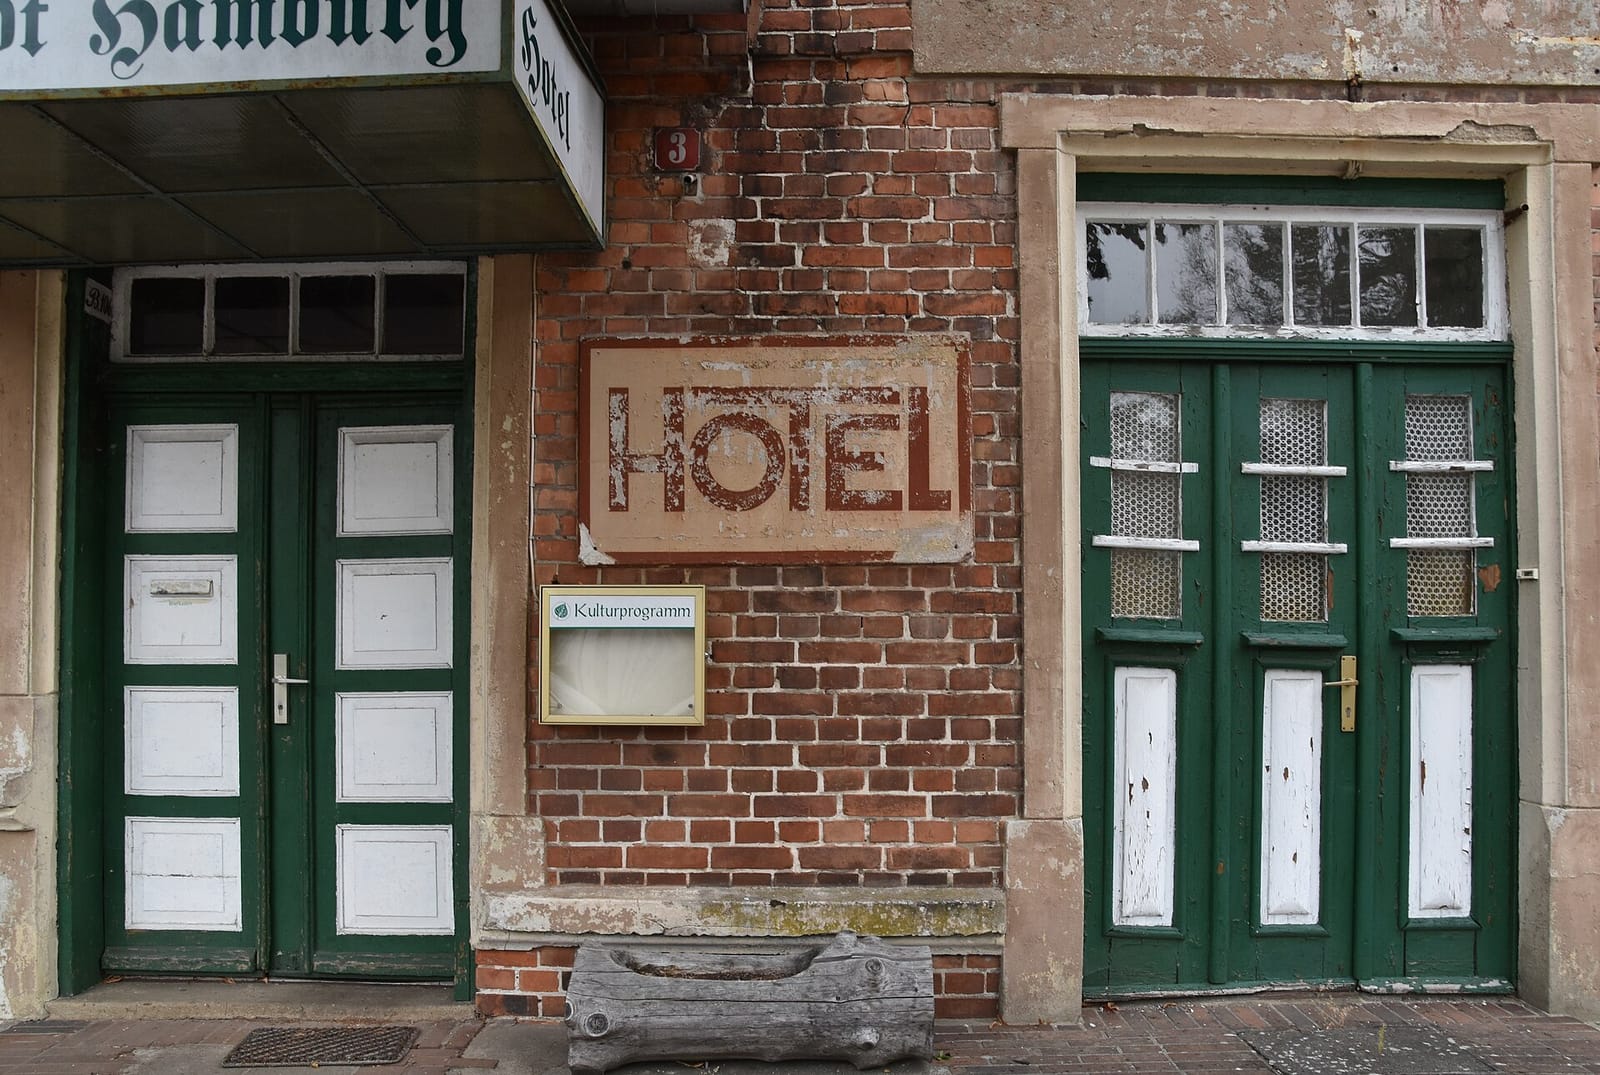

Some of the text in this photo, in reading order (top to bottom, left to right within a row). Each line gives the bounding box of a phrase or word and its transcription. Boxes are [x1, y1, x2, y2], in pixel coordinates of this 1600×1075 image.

[521, 6, 570, 152] Hotel
[668, 131, 687, 164] 3
[608, 386, 952, 512] HOTEL
[574, 602, 691, 621] Kulturprogramm
